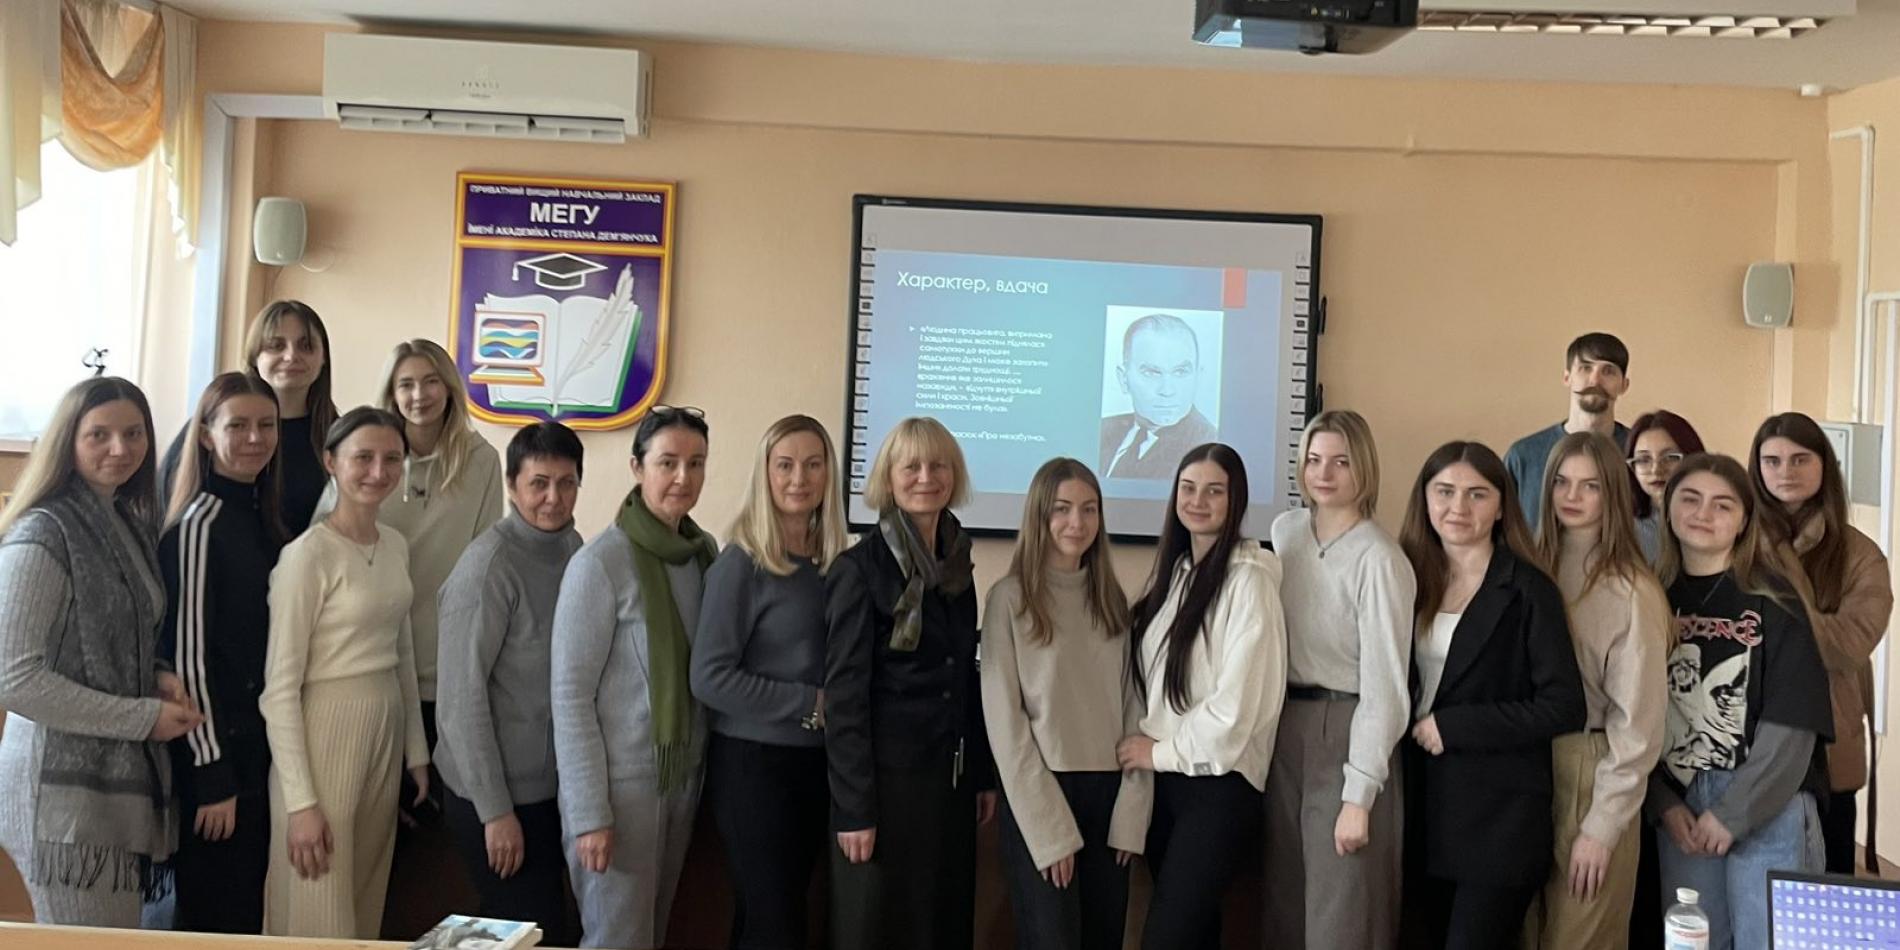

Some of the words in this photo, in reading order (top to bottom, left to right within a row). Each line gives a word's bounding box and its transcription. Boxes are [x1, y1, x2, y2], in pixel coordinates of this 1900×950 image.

[530, 202, 600, 225] МЕГУ
[467, 222, 495, 235] ІМЕНІ
[495, 225, 551, 238] АКАДЕМІКА
[551, 229, 596, 240] СТЕПАНА
[896, 271, 991, 294] Характер,
[996, 279, 1049, 294] вдача
